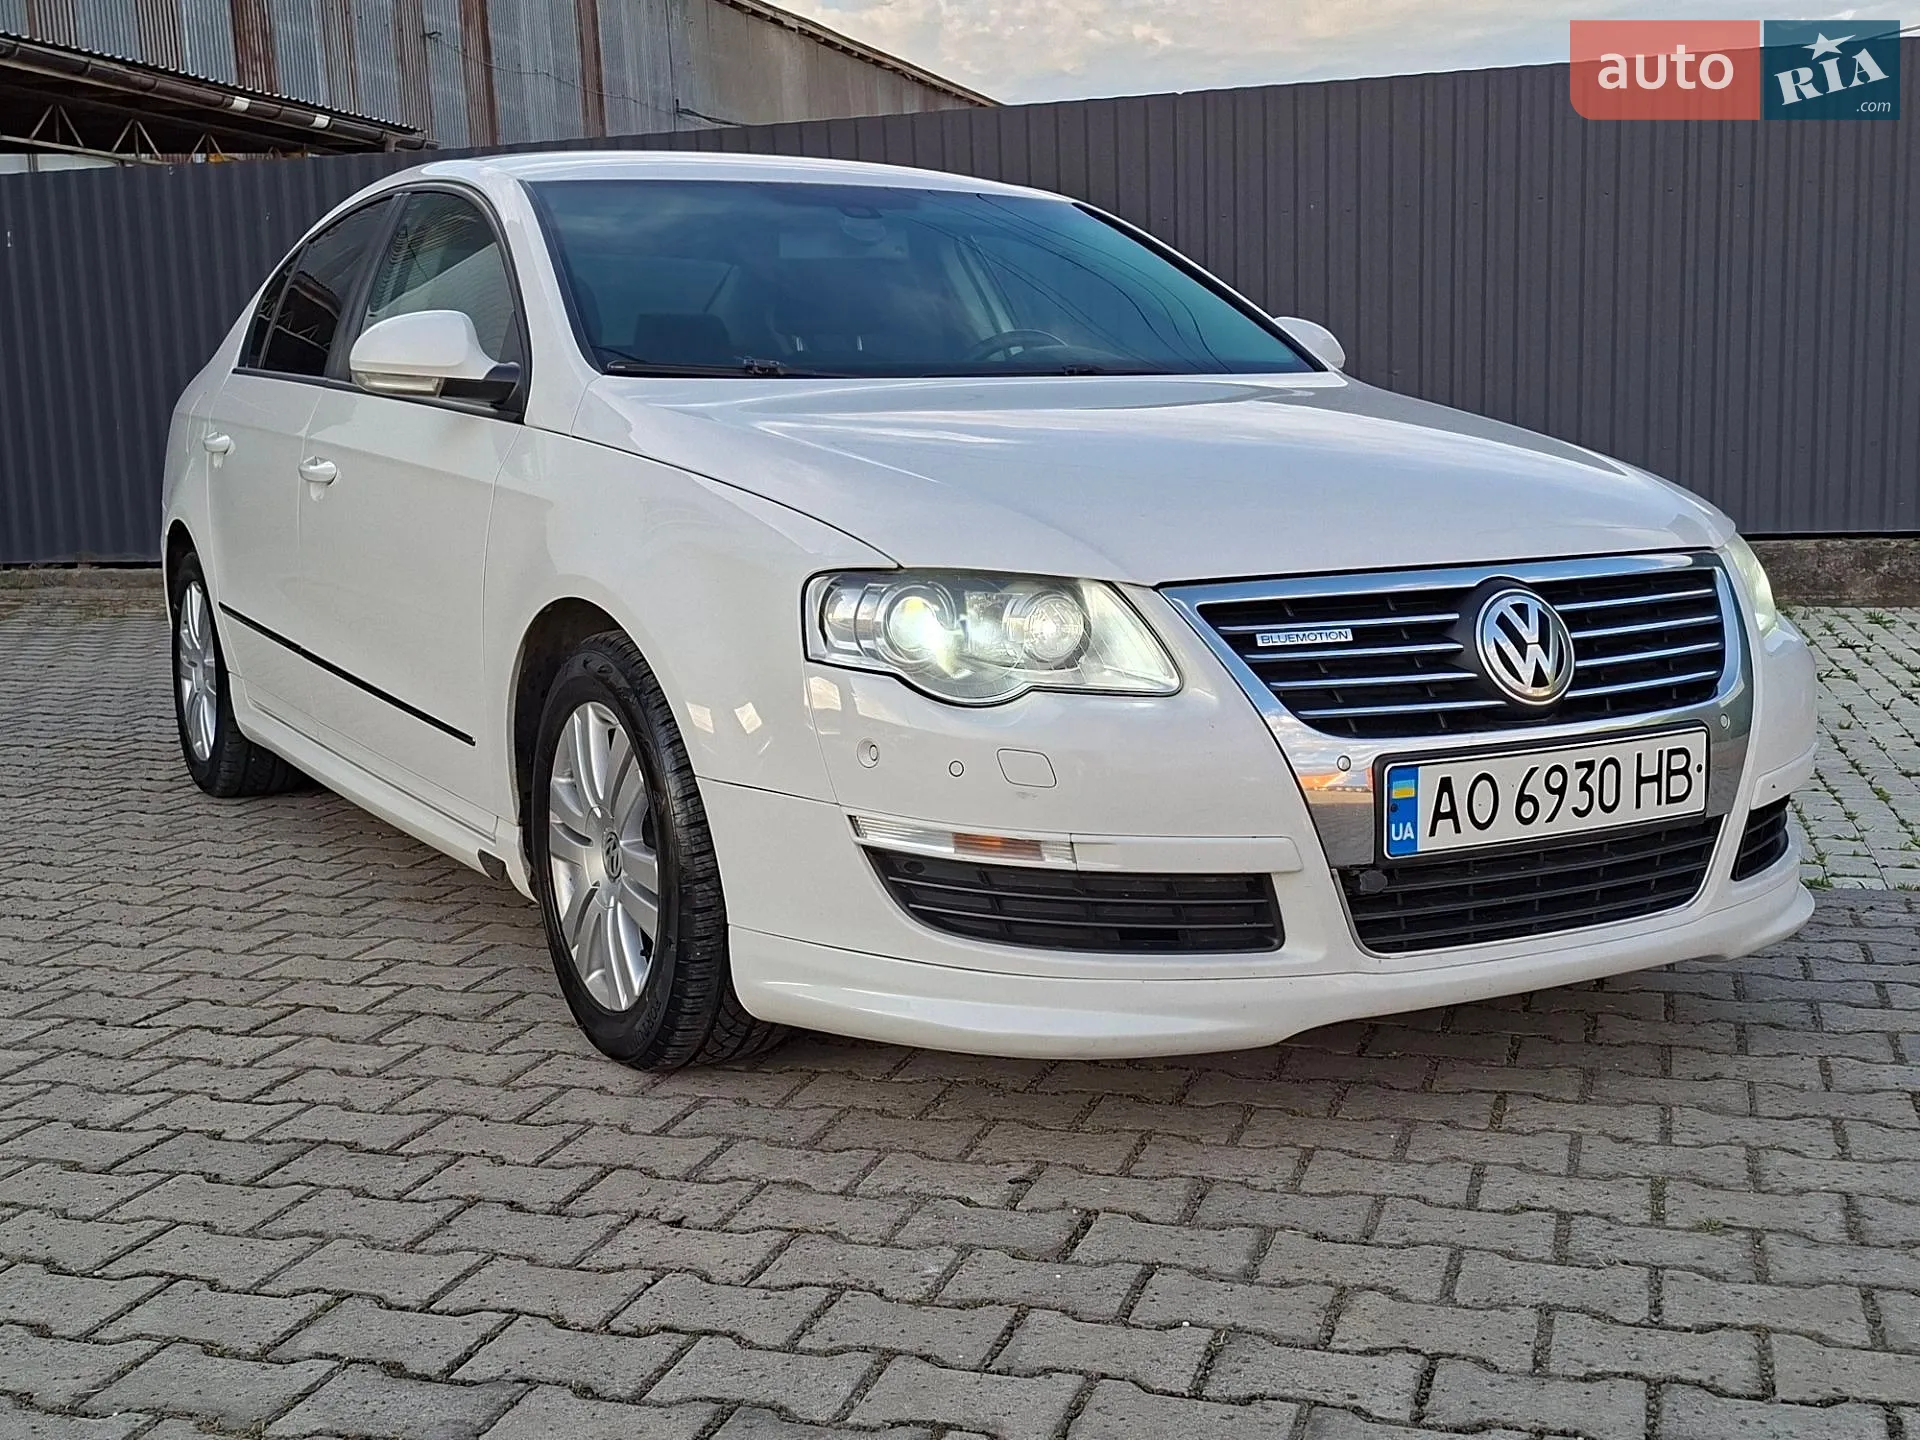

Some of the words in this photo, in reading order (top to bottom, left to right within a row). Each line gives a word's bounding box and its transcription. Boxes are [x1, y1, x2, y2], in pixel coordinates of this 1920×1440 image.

[1260, 630, 1349, 644] BLUEMOTION
[1428, 772, 1500, 838] AO
[1514, 756, 1622, 826] 6930
[1635, 746, 1694, 810] HB
[1391, 824, 1415, 841] UA
